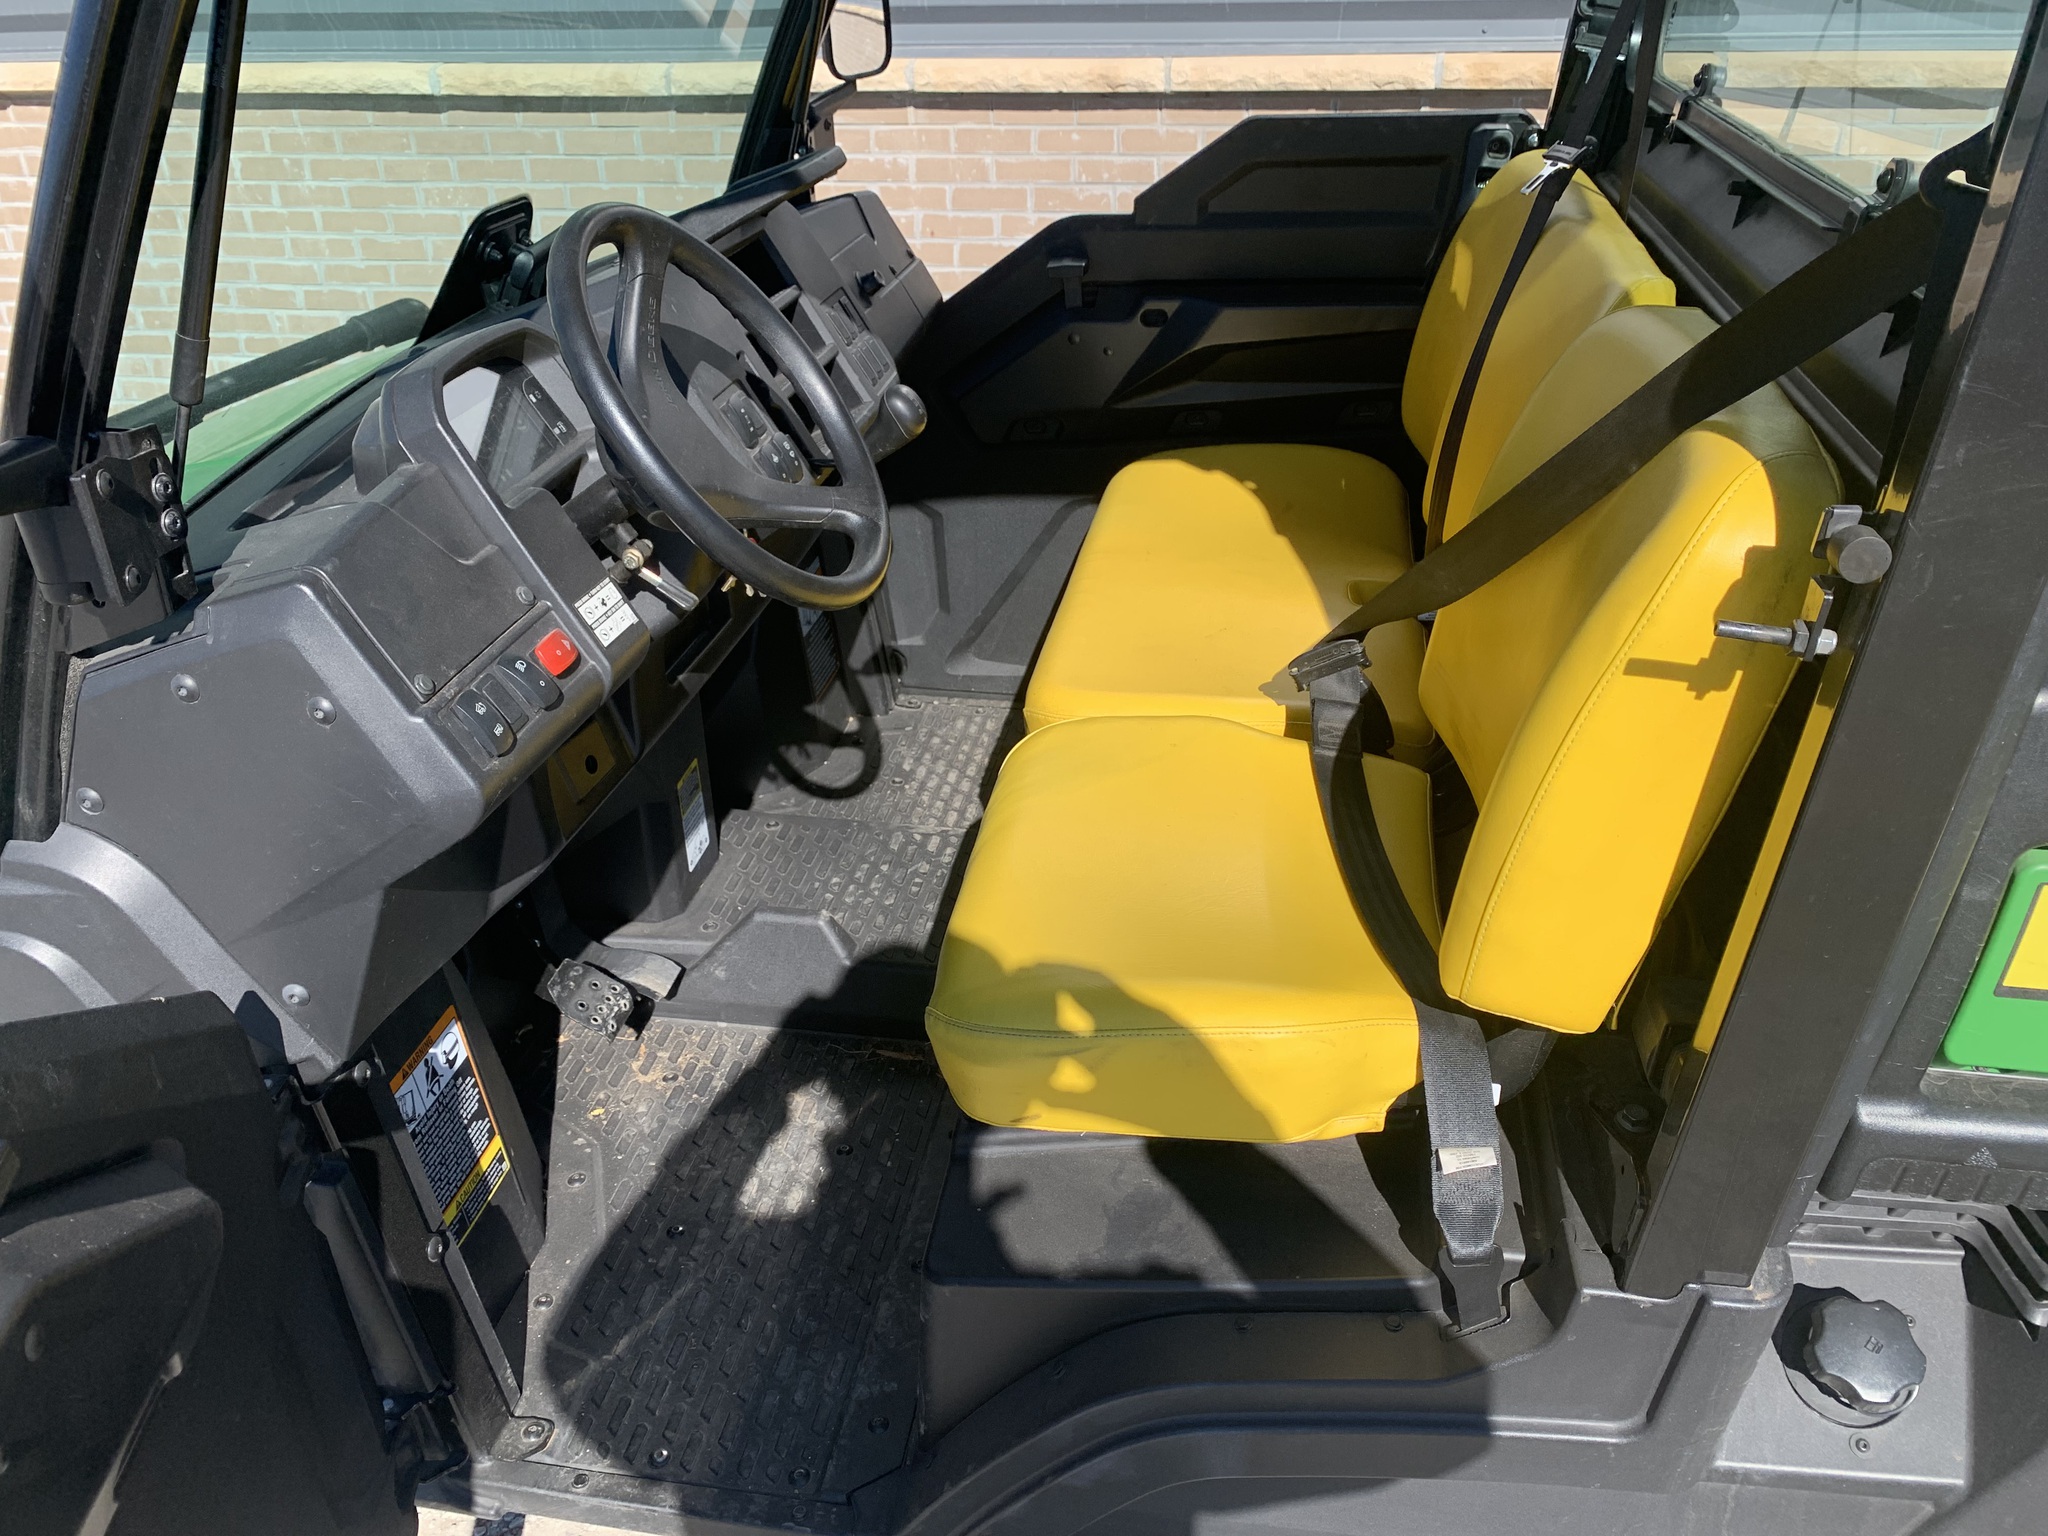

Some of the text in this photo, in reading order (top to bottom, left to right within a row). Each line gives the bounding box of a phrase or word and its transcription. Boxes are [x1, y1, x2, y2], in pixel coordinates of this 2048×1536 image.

[647, 296, 657, 363] DEERE
[406, 1035, 434, 1071] WARNING
[459, 1168, 481, 1202] CAUTION
